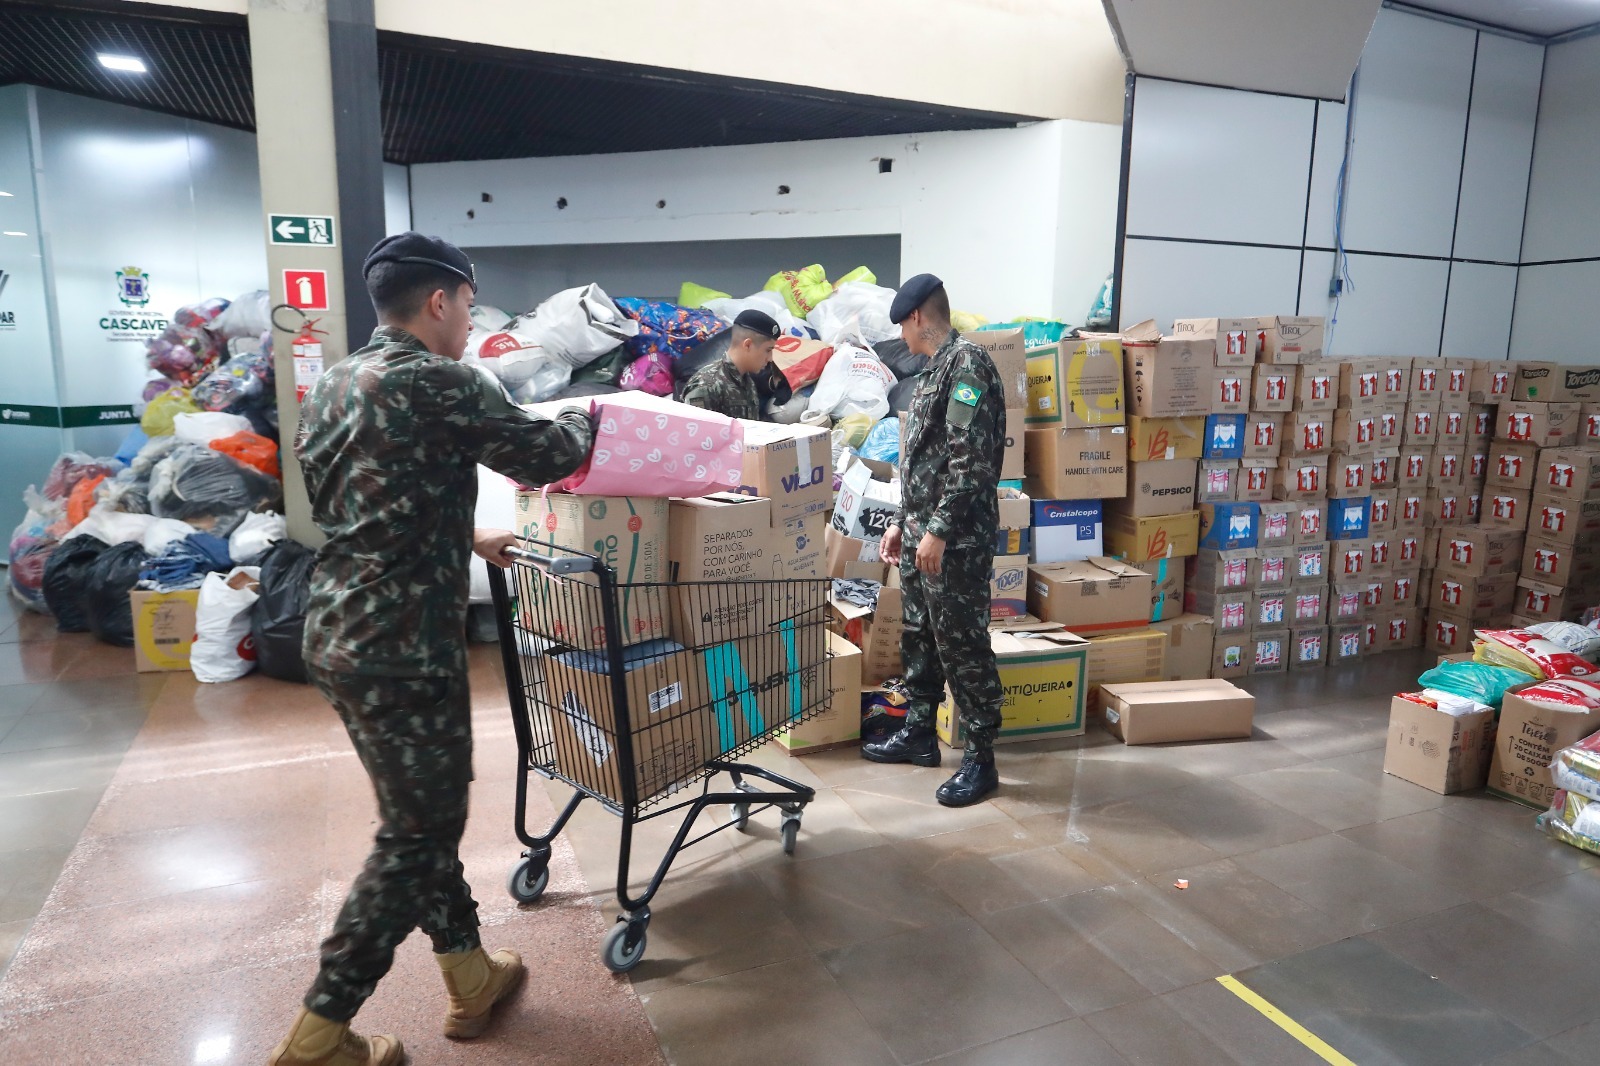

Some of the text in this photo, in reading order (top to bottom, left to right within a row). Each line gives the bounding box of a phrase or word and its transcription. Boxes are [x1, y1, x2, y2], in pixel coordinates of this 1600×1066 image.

[99, 318, 169, 330] CASCAVE
[1176, 322, 1196, 333] TIROL
[1281, 325, 1302, 336] TIROL
[1027, 376, 1048, 387] QUEIRA
[99, 411, 131, 419] JUNTA
[1079, 451, 1110, 460] FRAGILE
[1066, 465, 1123, 475] HANDLE WITH CARE
[1152, 486, 1192, 496] PEPSICO
[1050, 509, 1098, 518] Cristalcopo
[704, 528, 753, 543] SEPARADOS
[1081, 525, 1091, 535] PS
[704, 540, 745, 555] POR NÓS,
[704, 548, 762, 566] COM CARINHO
[703, 567, 728, 578] PARA
[1003, 681, 1066, 696] NTIQUEIRA
[1001, 697, 1015, 706] sil
[1514, 744, 1553, 761] 20 CAIXAS
[1516, 752, 1526, 760] DE
